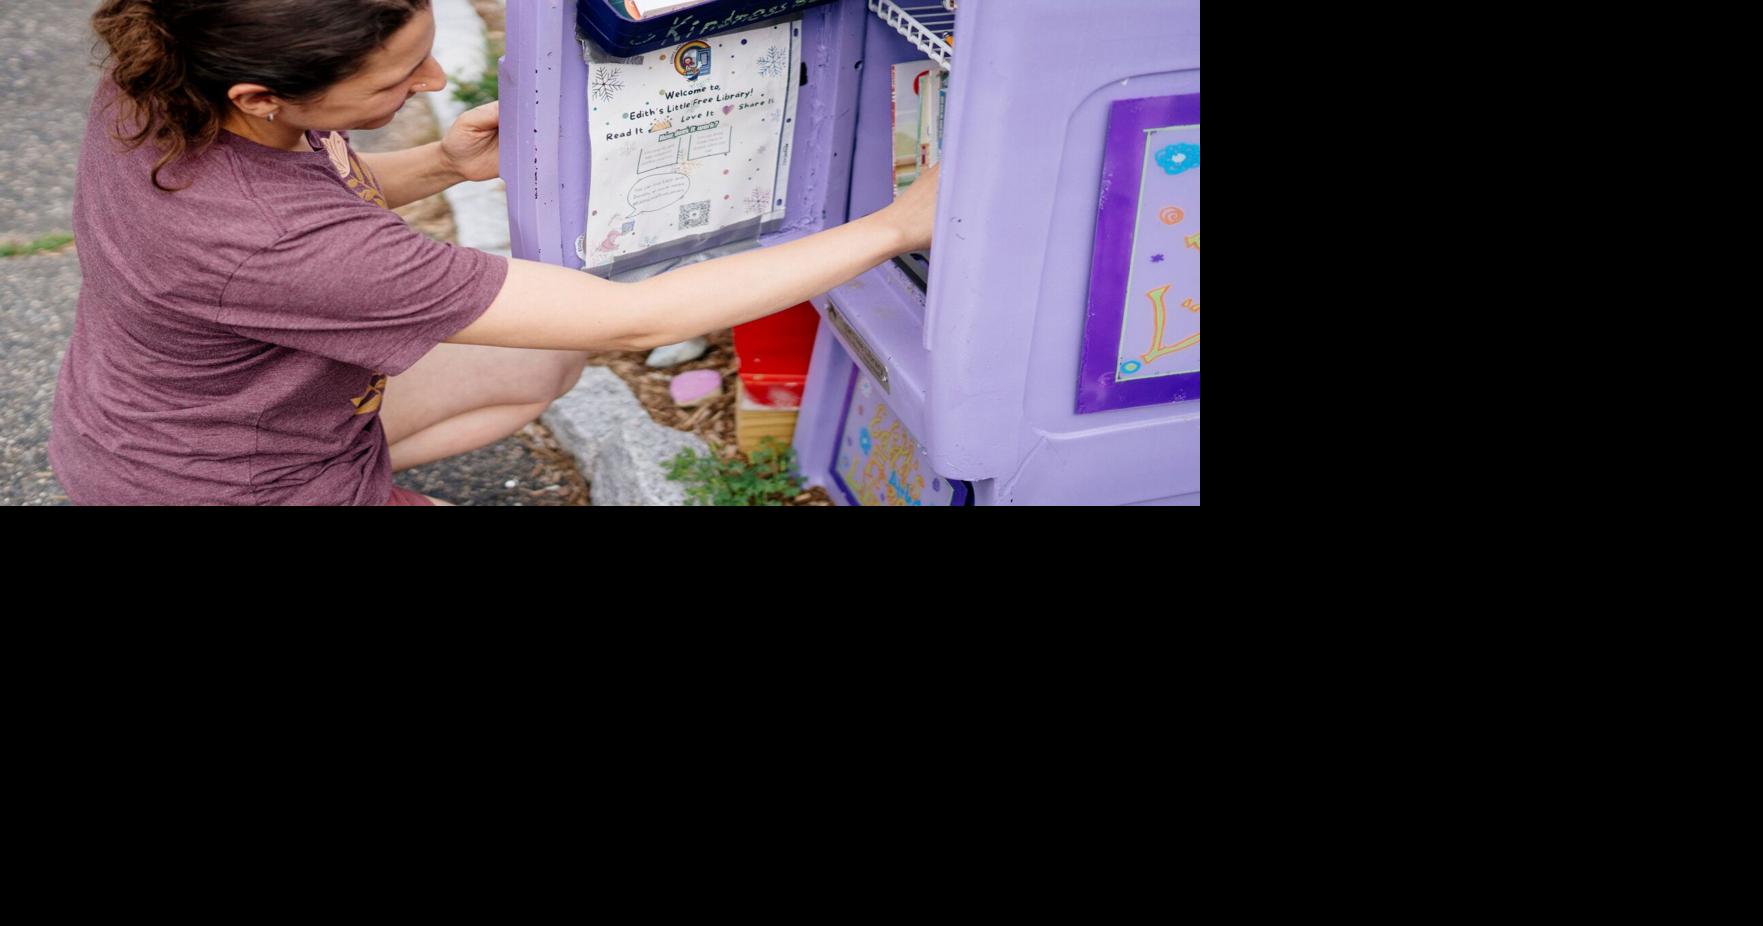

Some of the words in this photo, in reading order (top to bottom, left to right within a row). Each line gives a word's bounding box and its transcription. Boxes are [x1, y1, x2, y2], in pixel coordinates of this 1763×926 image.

[661, 2, 787, 46] Kindness
[629, 108, 664, 120] Edith's
[667, 100, 691, 113] Little
[693, 97, 714, 107] Free
[716, 87, 754, 102] Library!
[665, 85, 707, 100] Welcome
[606, 128, 632, 141] Read
[635, 127, 644, 135] It
[680, 113, 702, 123] Love
[738, 100, 765, 110] Share
